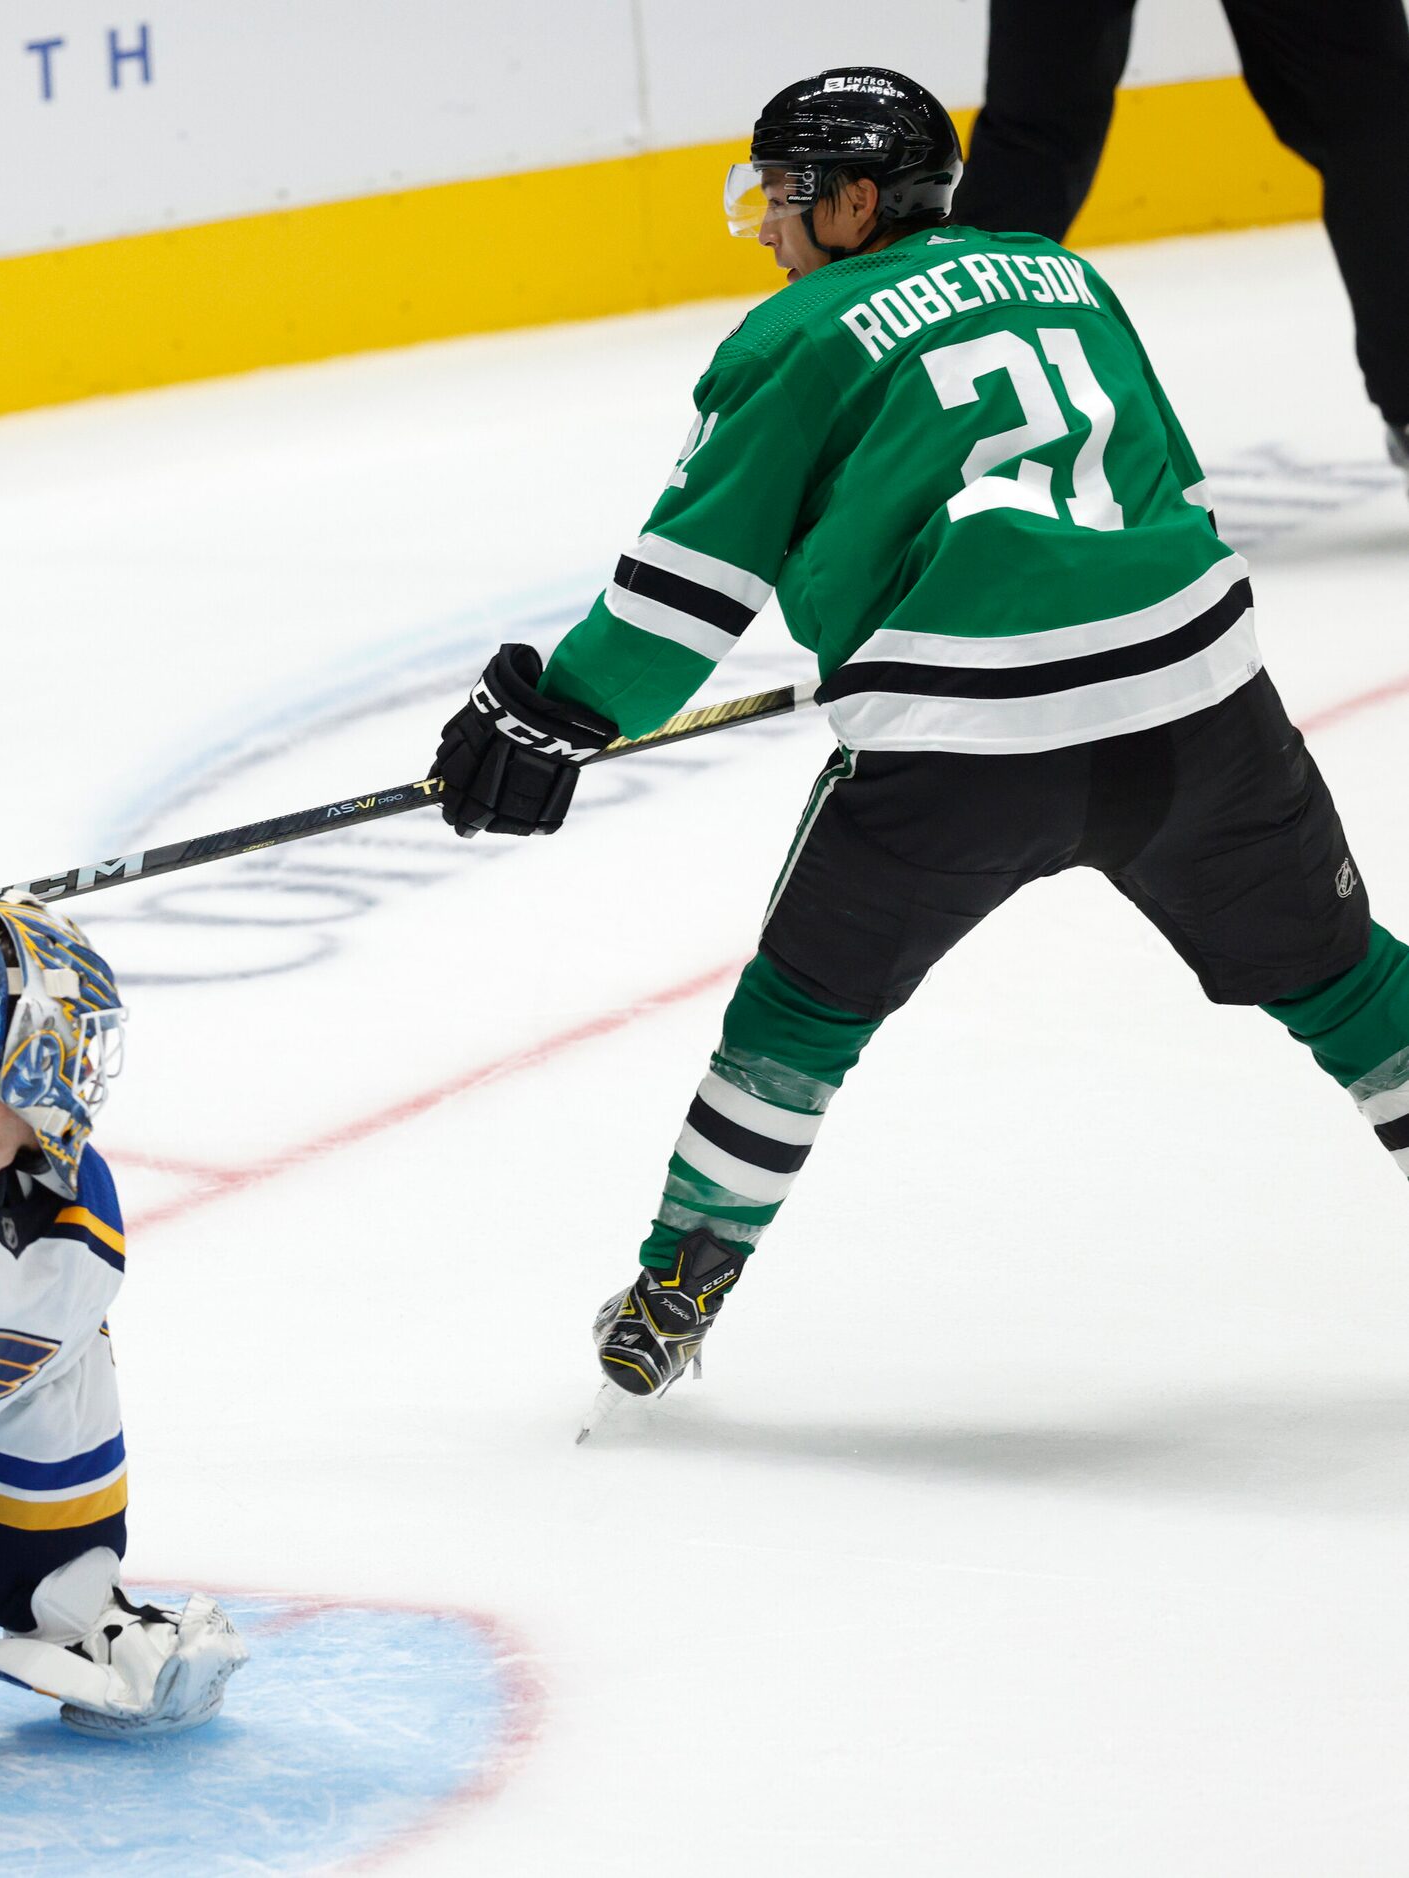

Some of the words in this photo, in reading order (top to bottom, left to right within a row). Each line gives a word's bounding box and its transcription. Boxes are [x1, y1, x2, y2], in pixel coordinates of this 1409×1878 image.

[839, 253, 1101, 363] ROBERTSON
[920, 327, 1125, 532] 21
[471, 676, 602, 762] CCM
[378, 793, 405, 806] PRO
[701, 1268, 736, 1293] CCM
[659, 1297, 692, 1321] TACKS
